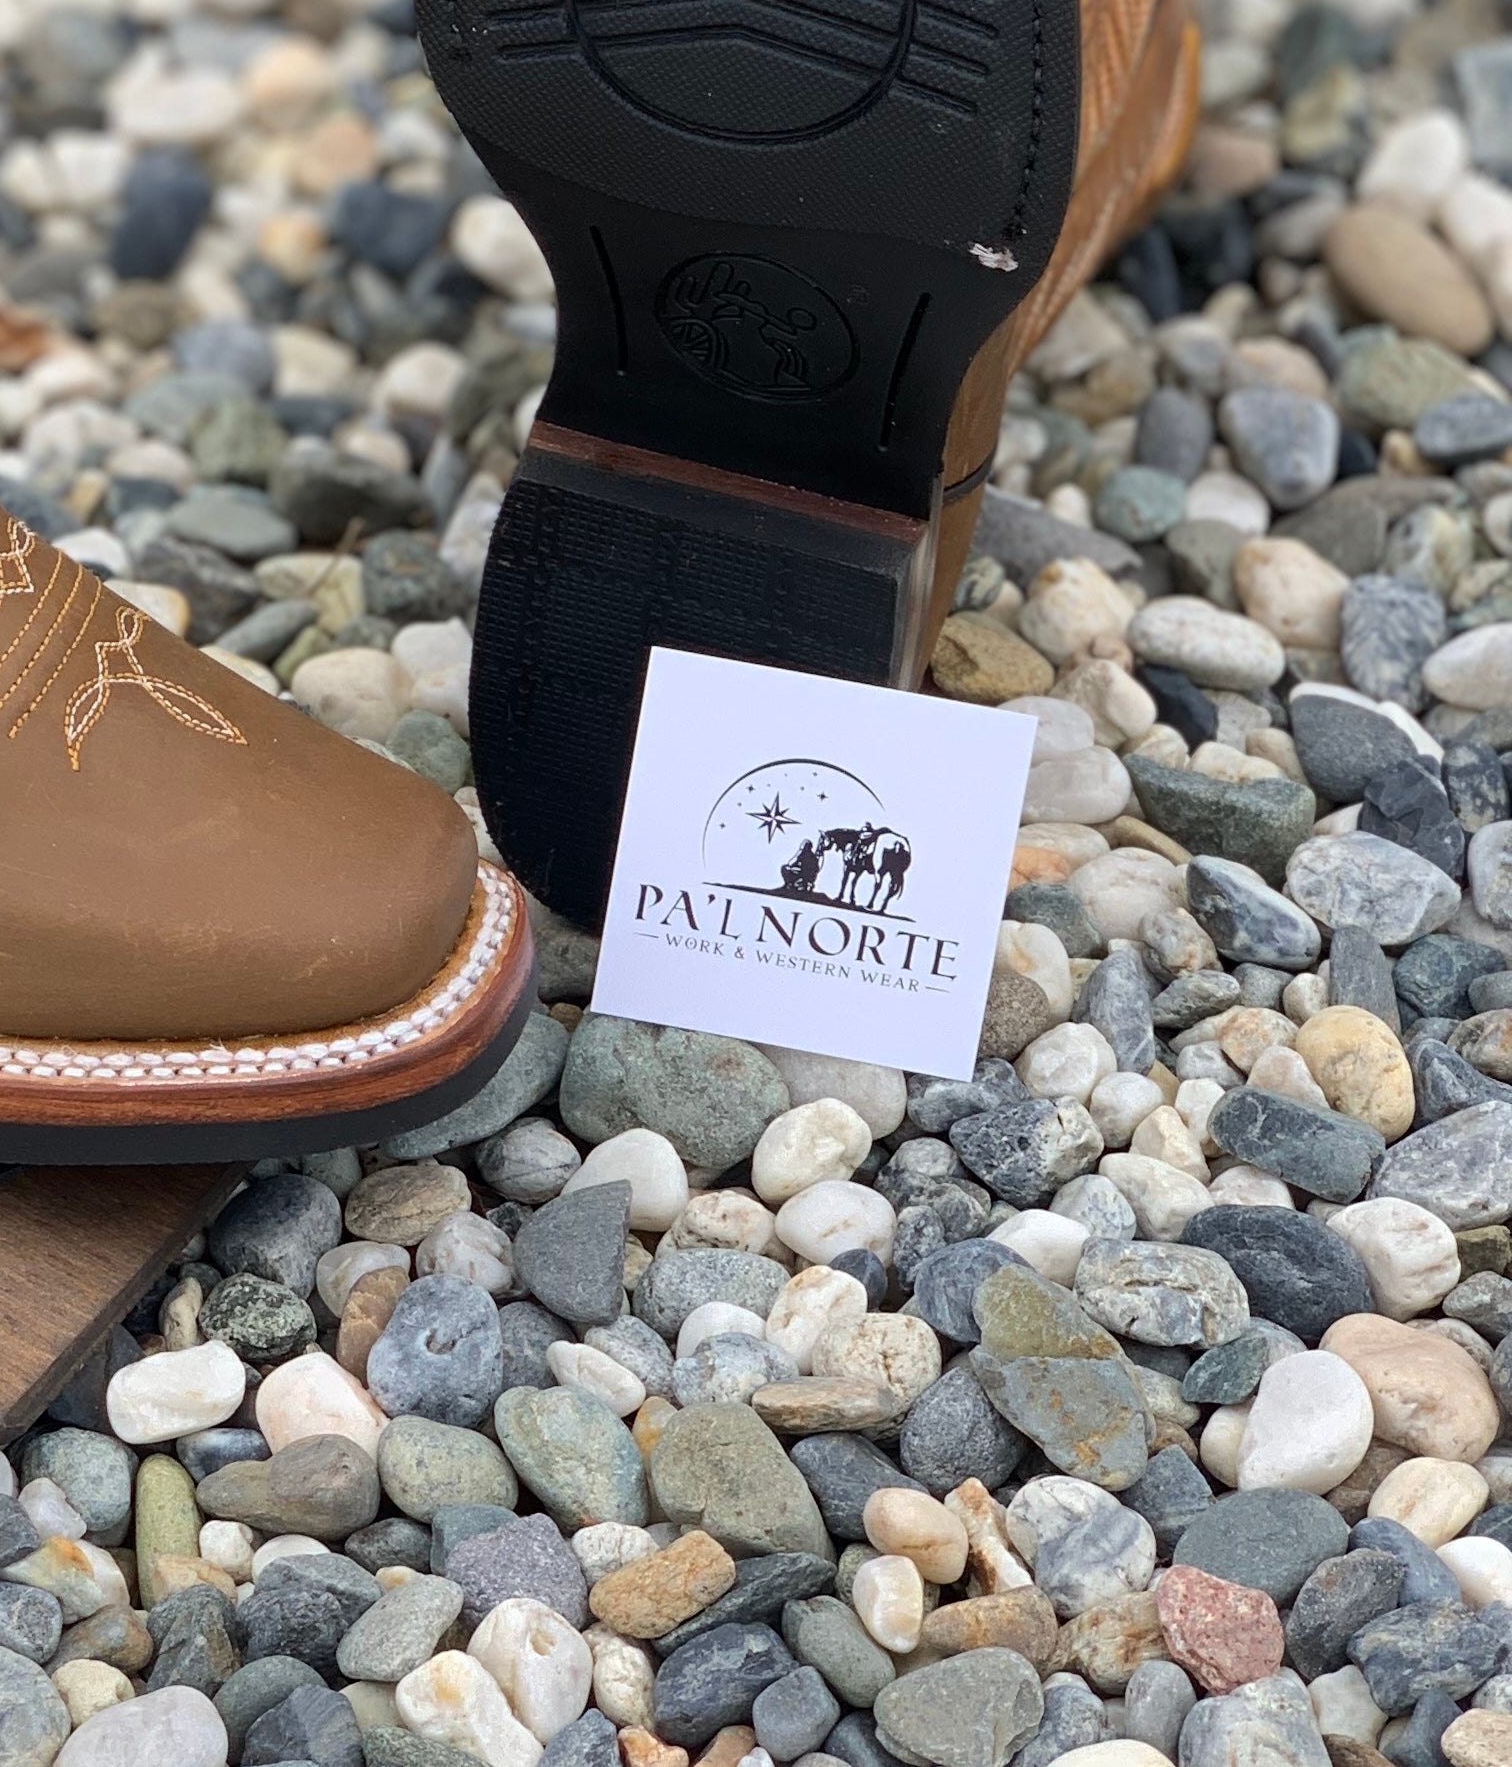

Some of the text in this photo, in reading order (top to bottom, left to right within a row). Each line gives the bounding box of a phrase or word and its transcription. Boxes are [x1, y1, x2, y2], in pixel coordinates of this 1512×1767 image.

[635, 884, 959, 981] PA'L NORTE
[666, 933, 919, 992] WORK & WESTERN WEAR
